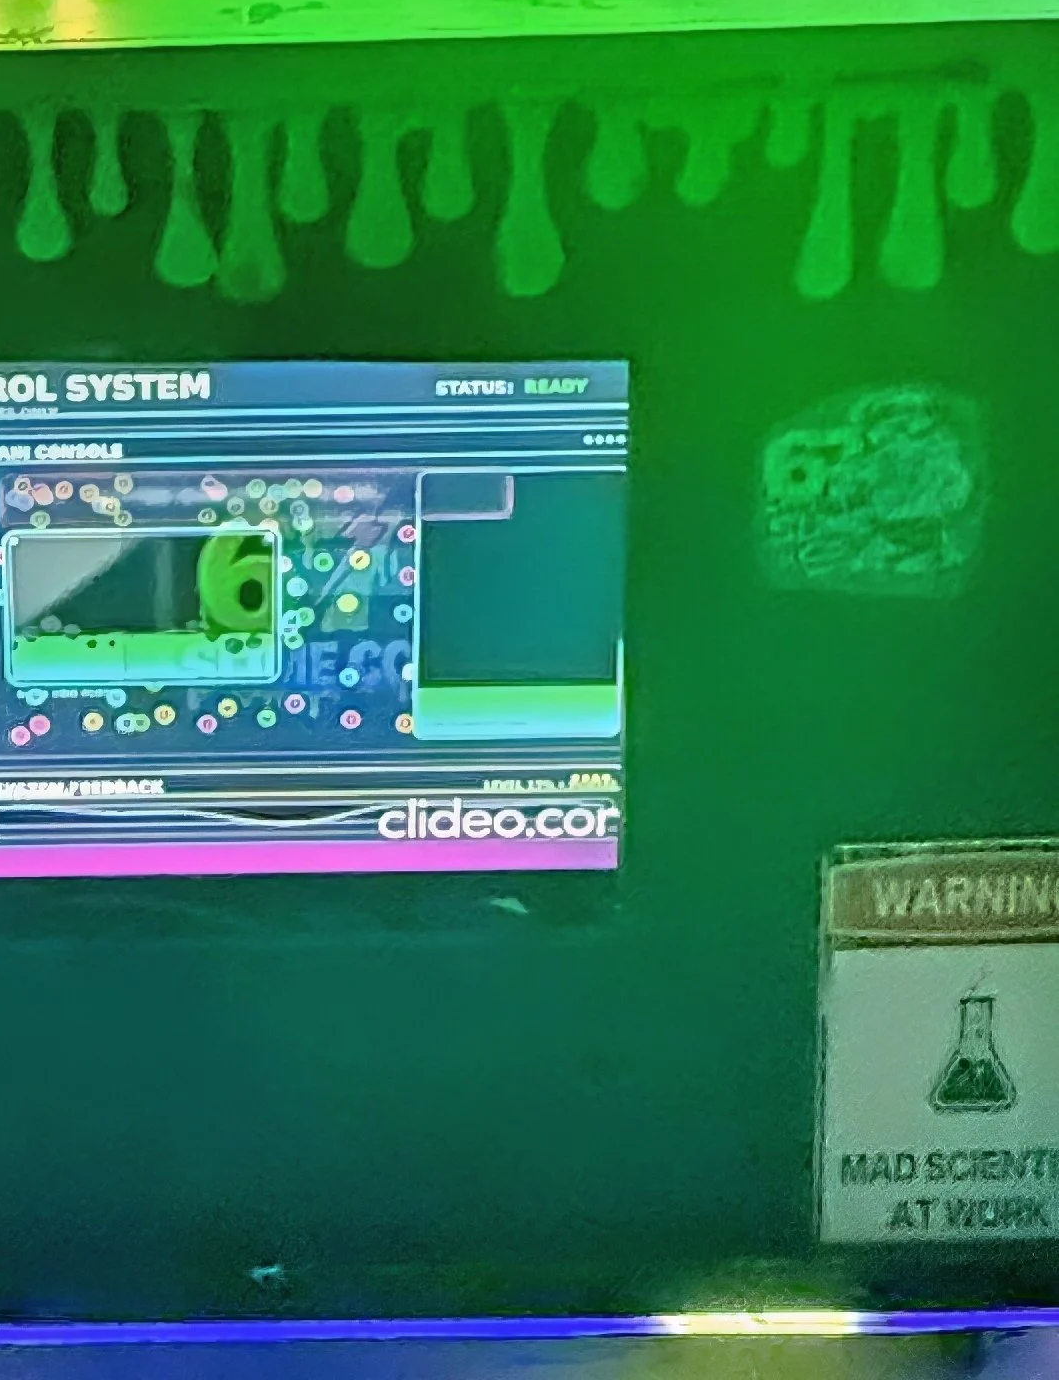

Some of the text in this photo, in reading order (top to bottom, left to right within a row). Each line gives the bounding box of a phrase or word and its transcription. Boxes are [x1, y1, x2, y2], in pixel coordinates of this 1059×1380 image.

[65, 372, 211, 402] SYSTEM
[435, 377, 589, 396] STATUS: READY
[33, 442, 123, 460] CONSOLE
[871, 875, 1059, 917] WARNIN
[841, 1152, 917, 1184] MAD
[886, 1194, 1049, 1229] AT WORK
